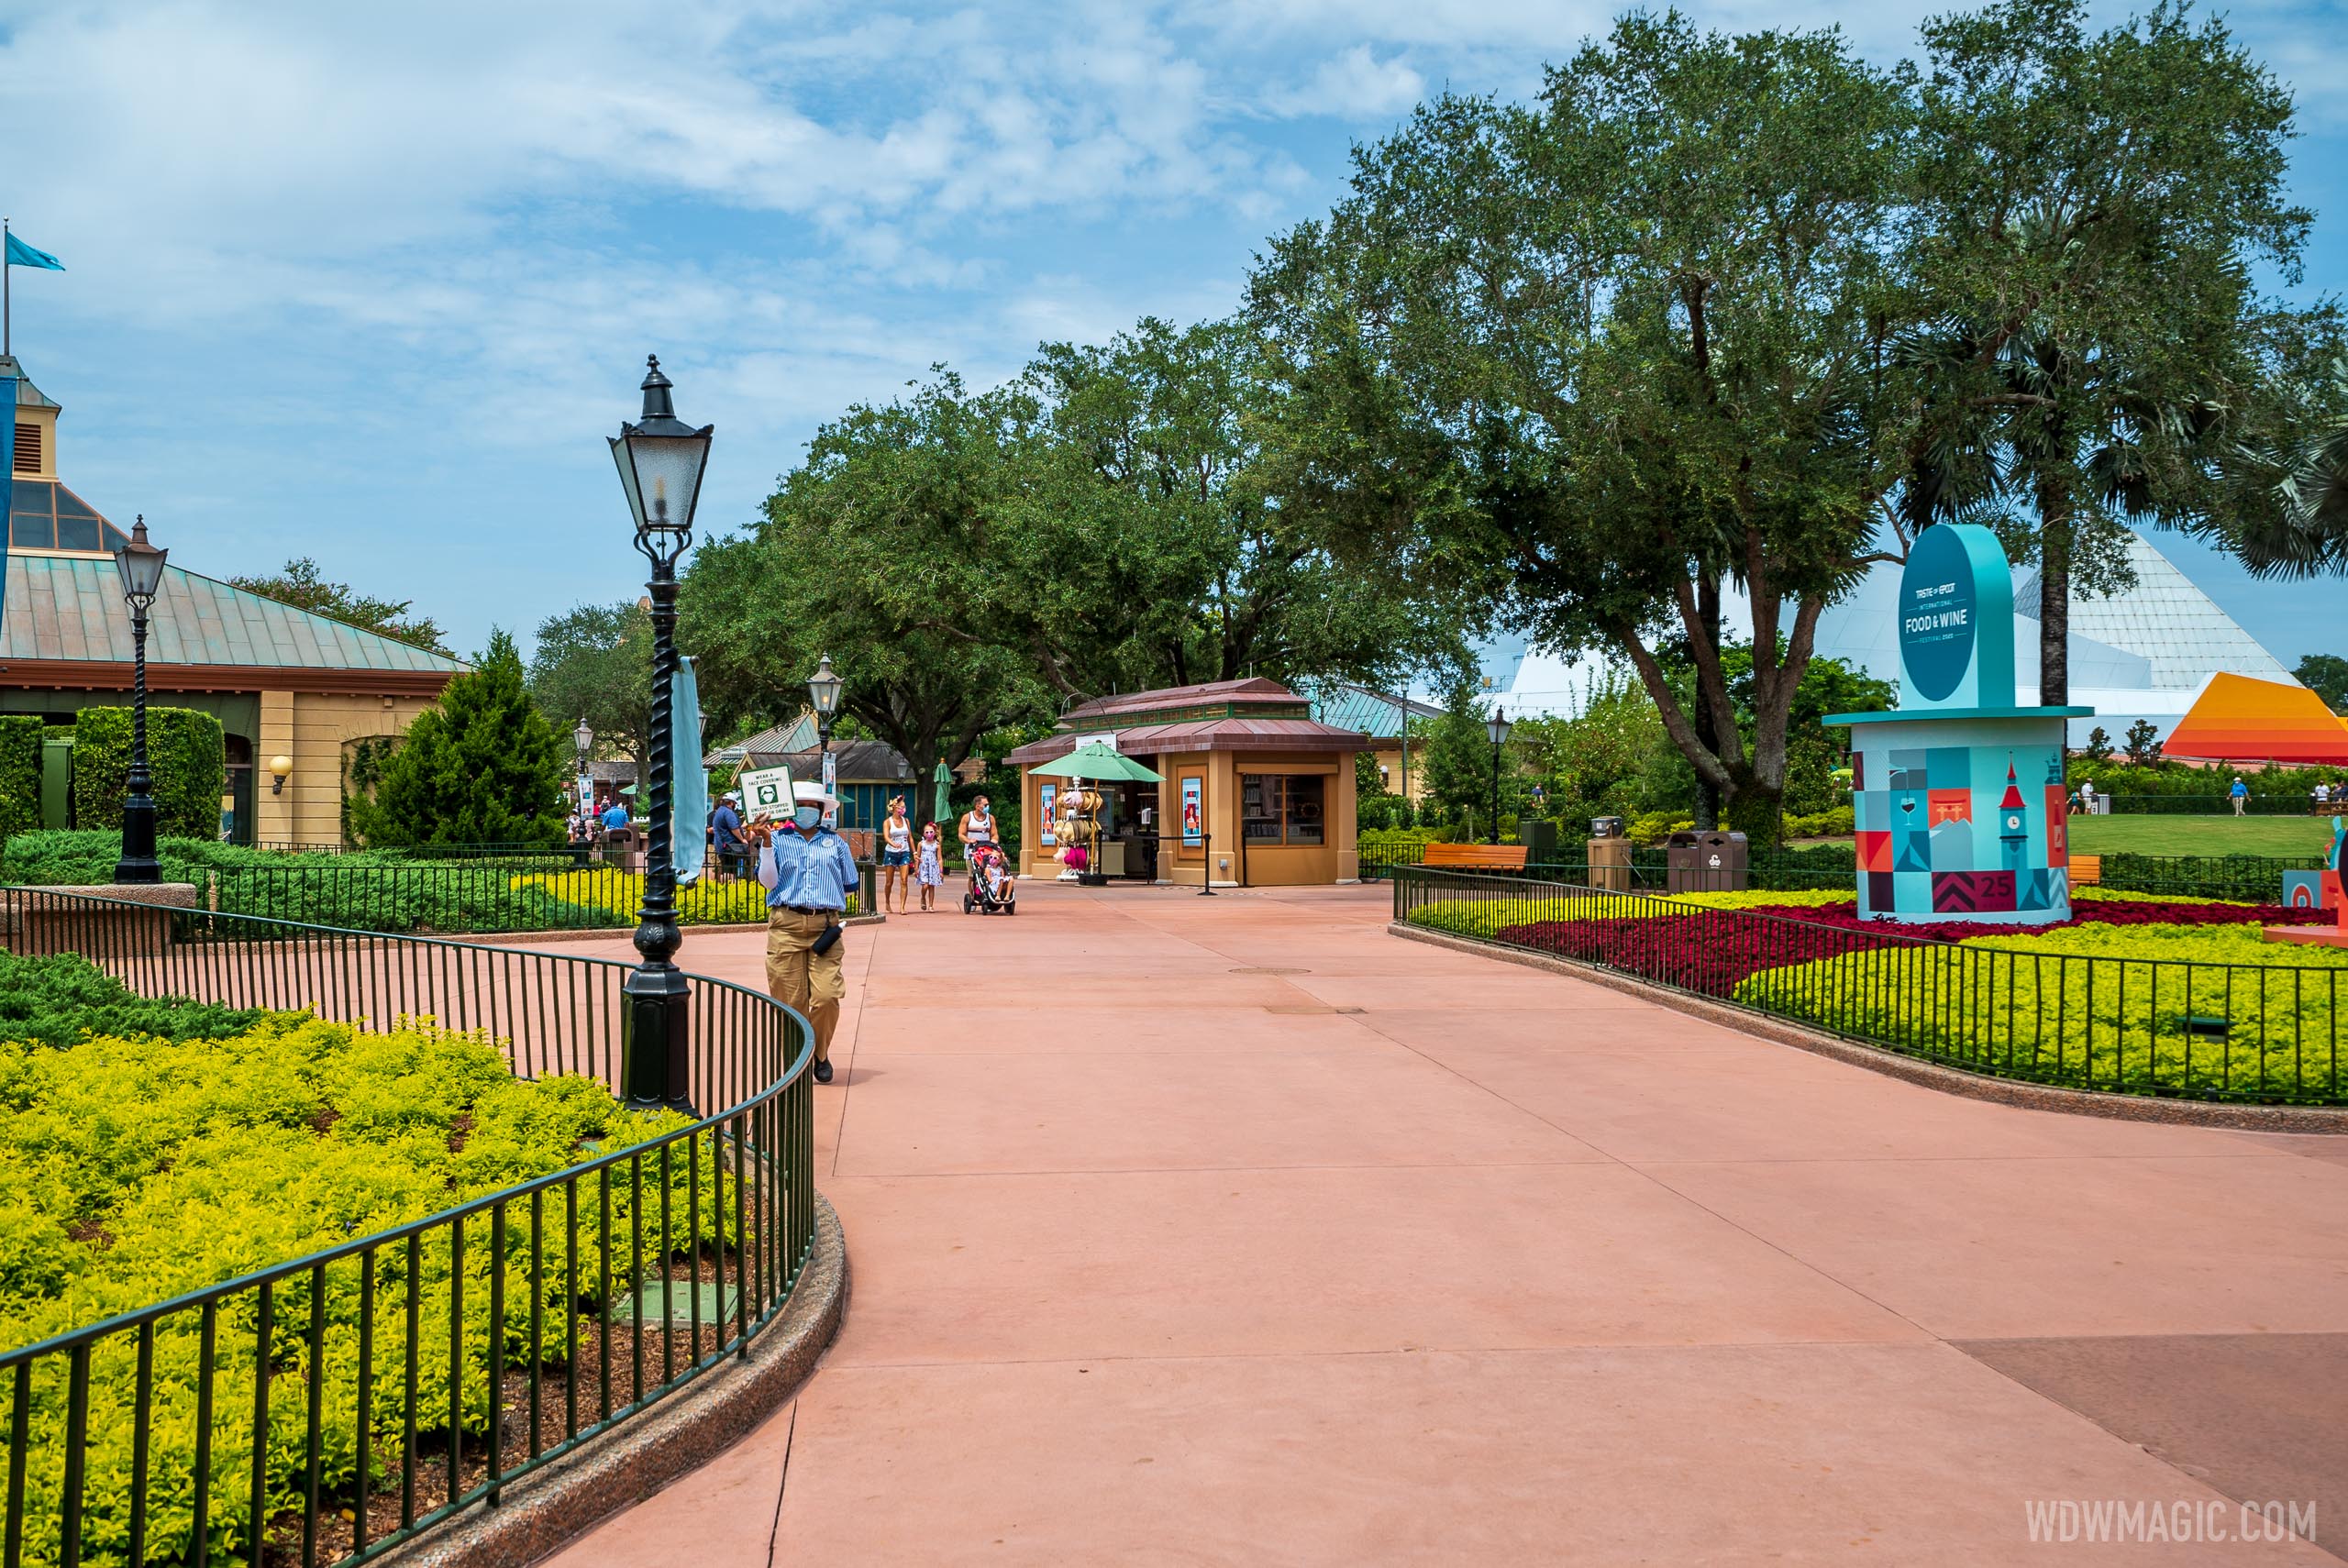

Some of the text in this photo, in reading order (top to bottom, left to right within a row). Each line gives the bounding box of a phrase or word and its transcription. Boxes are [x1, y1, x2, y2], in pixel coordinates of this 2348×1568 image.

[1916, 588, 1933, 599] TASTE
[1906, 609, 1967, 634] FOOD & WINE
[1981, 877, 2011, 897] 25
